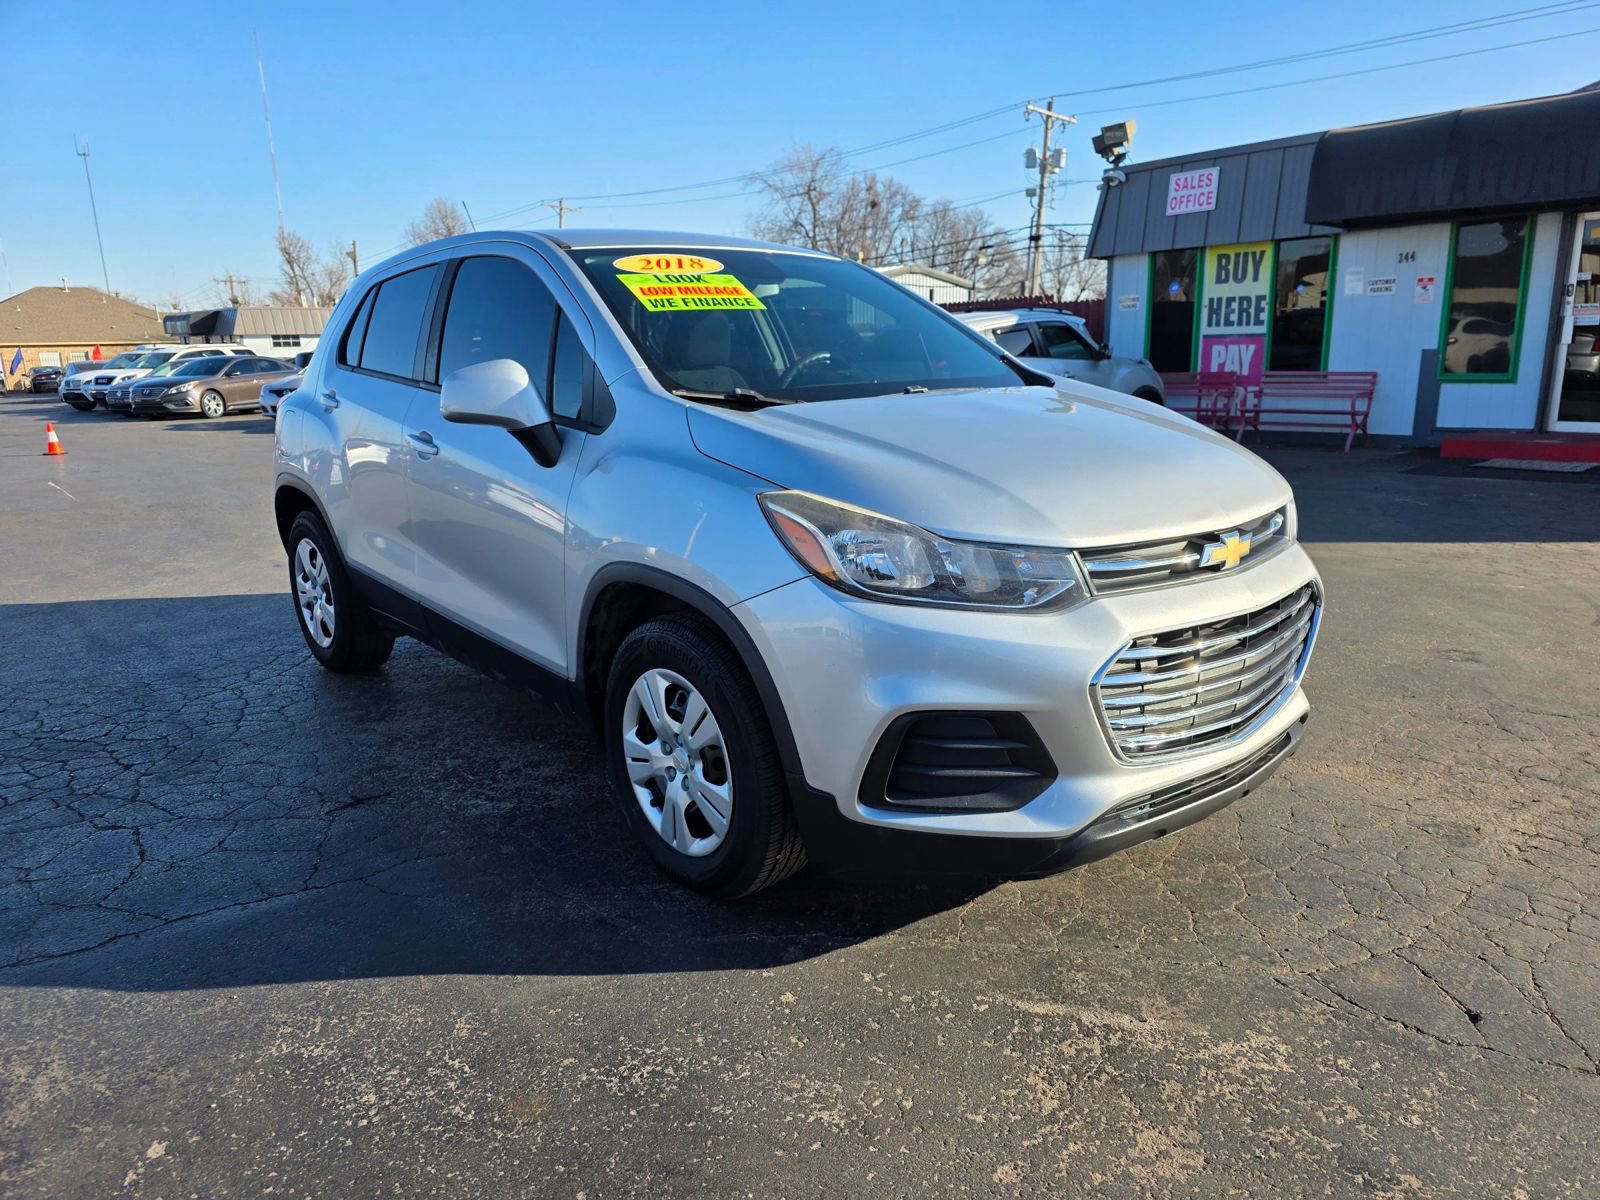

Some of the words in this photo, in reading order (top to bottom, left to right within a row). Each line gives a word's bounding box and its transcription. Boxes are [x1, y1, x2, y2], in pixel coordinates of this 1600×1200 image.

[1174, 172, 1213, 192] SALES
[1170, 192, 1214, 211] OFFICE
[639, 258, 704, 270] 2018
[1397, 251, 1416, 264] 344
[1214, 250, 1266, 285] BUY
[654, 274, 707, 283] LOOK
[1368, 278, 1397, 287] CUSTOMER
[639, 287, 676, 296] LOW
[678, 286, 744, 296] MILEAGE
[647, 298, 678, 308] WE
[682, 297, 757, 307] FINANCE
[1206, 294, 1267, 328] HERE
[1209, 344, 1256, 376] PAY
